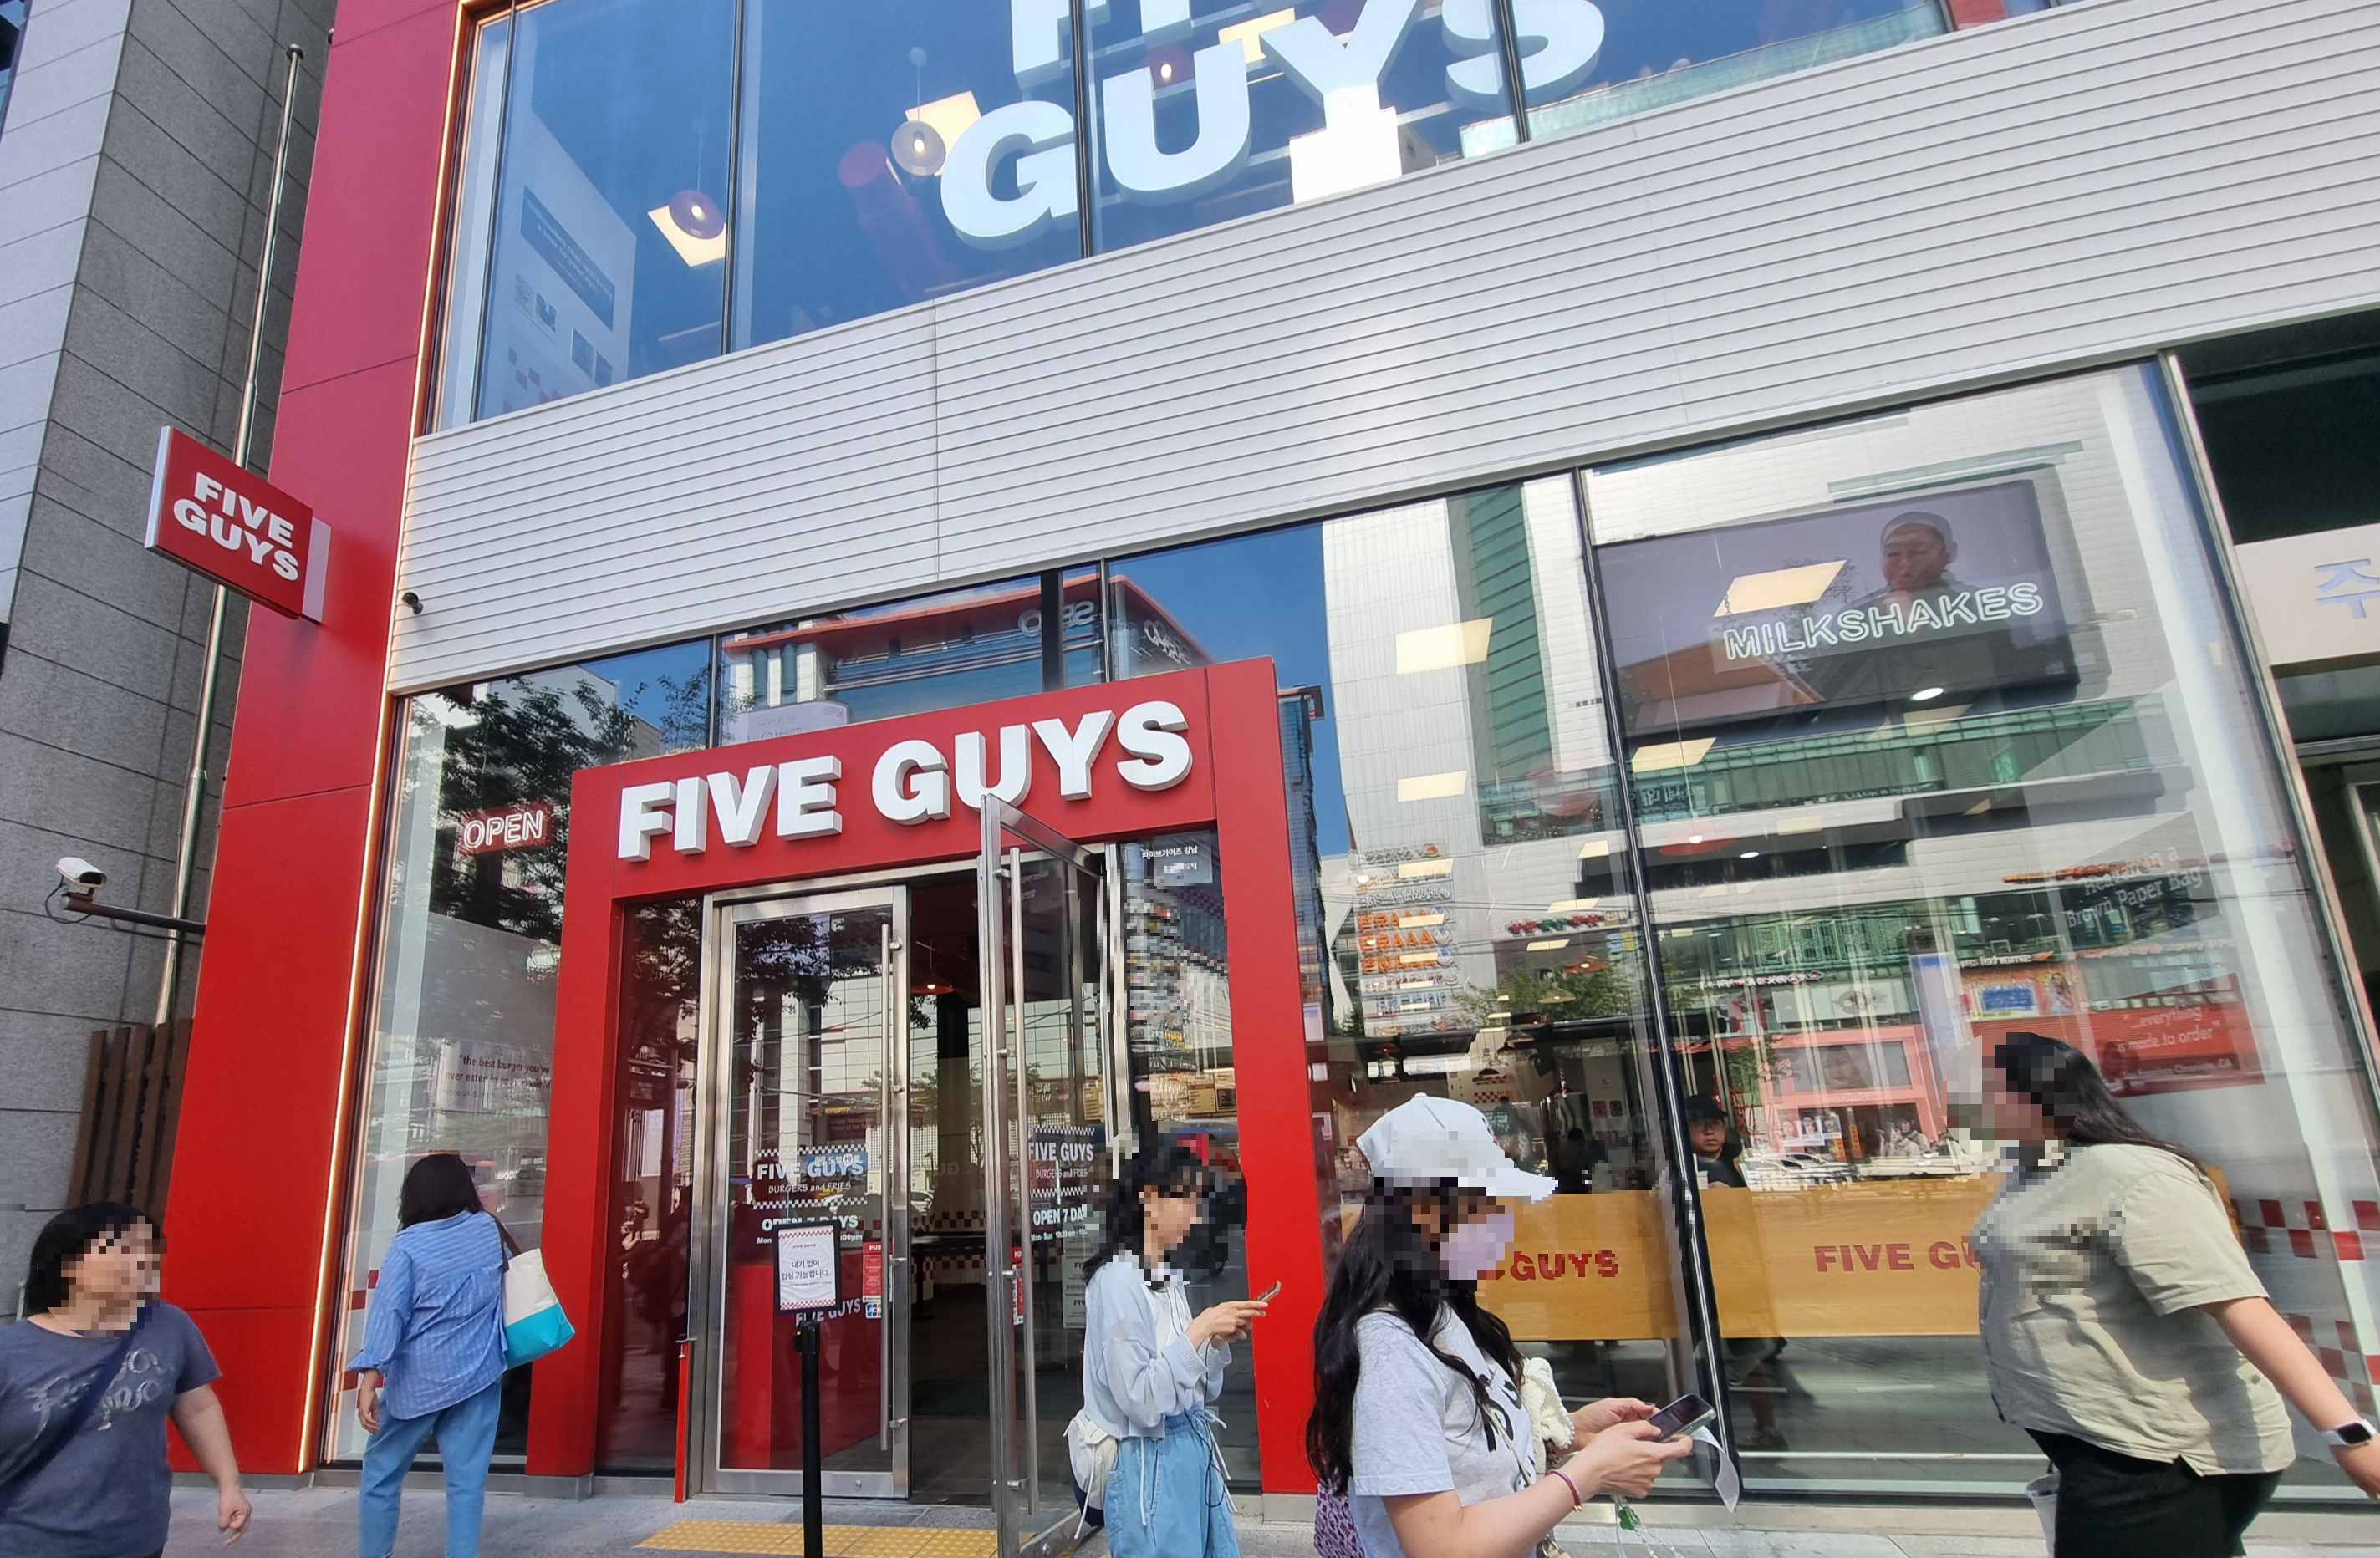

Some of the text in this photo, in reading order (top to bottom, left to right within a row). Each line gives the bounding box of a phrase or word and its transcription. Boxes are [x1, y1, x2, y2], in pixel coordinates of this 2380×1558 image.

[940, 0, 1606, 250] GUYS
[194, 471, 294, 548] FIVE
[172, 499, 299, 583] GUYS
[2313, 558, 2380, 620] 주
[1723, 582, 2043, 661] MILKSHAKES
[618, 700, 1194, 863] FIVE GUYS
[463, 808, 544, 850] OPEN
[2167, 845, 2179, 862] a
[2066, 899, 2112, 928] Brown
[2116, 879, 2163, 909] Paper
[2163, 1032, 2176, 1045] to
[446, 1072, 463, 1081] ever
[479, 1056, 495, 1068] best
[497, 1059, 523, 1072] burger
[1028, 1142, 1094, 1162] FIVE GUYS
[757, 1163, 800, 1180] FIVE
[808, 1160, 864, 1178] GUYS
[1036, 1168, 1062, 1179] BURGERS
[1063, 1169, 1072, 1179] and
[768, 1181, 851, 1194] BURGERS and FRIES
[1033, 1208, 1061, 1226] OPEN
[1063, 1209, 1068, 1222] 7
[791, 1259, 820, 1269] 대기 없어
[1509, 1250, 1620, 1281] GUYS
[1814, 1243, 1914, 1273] FIVE
